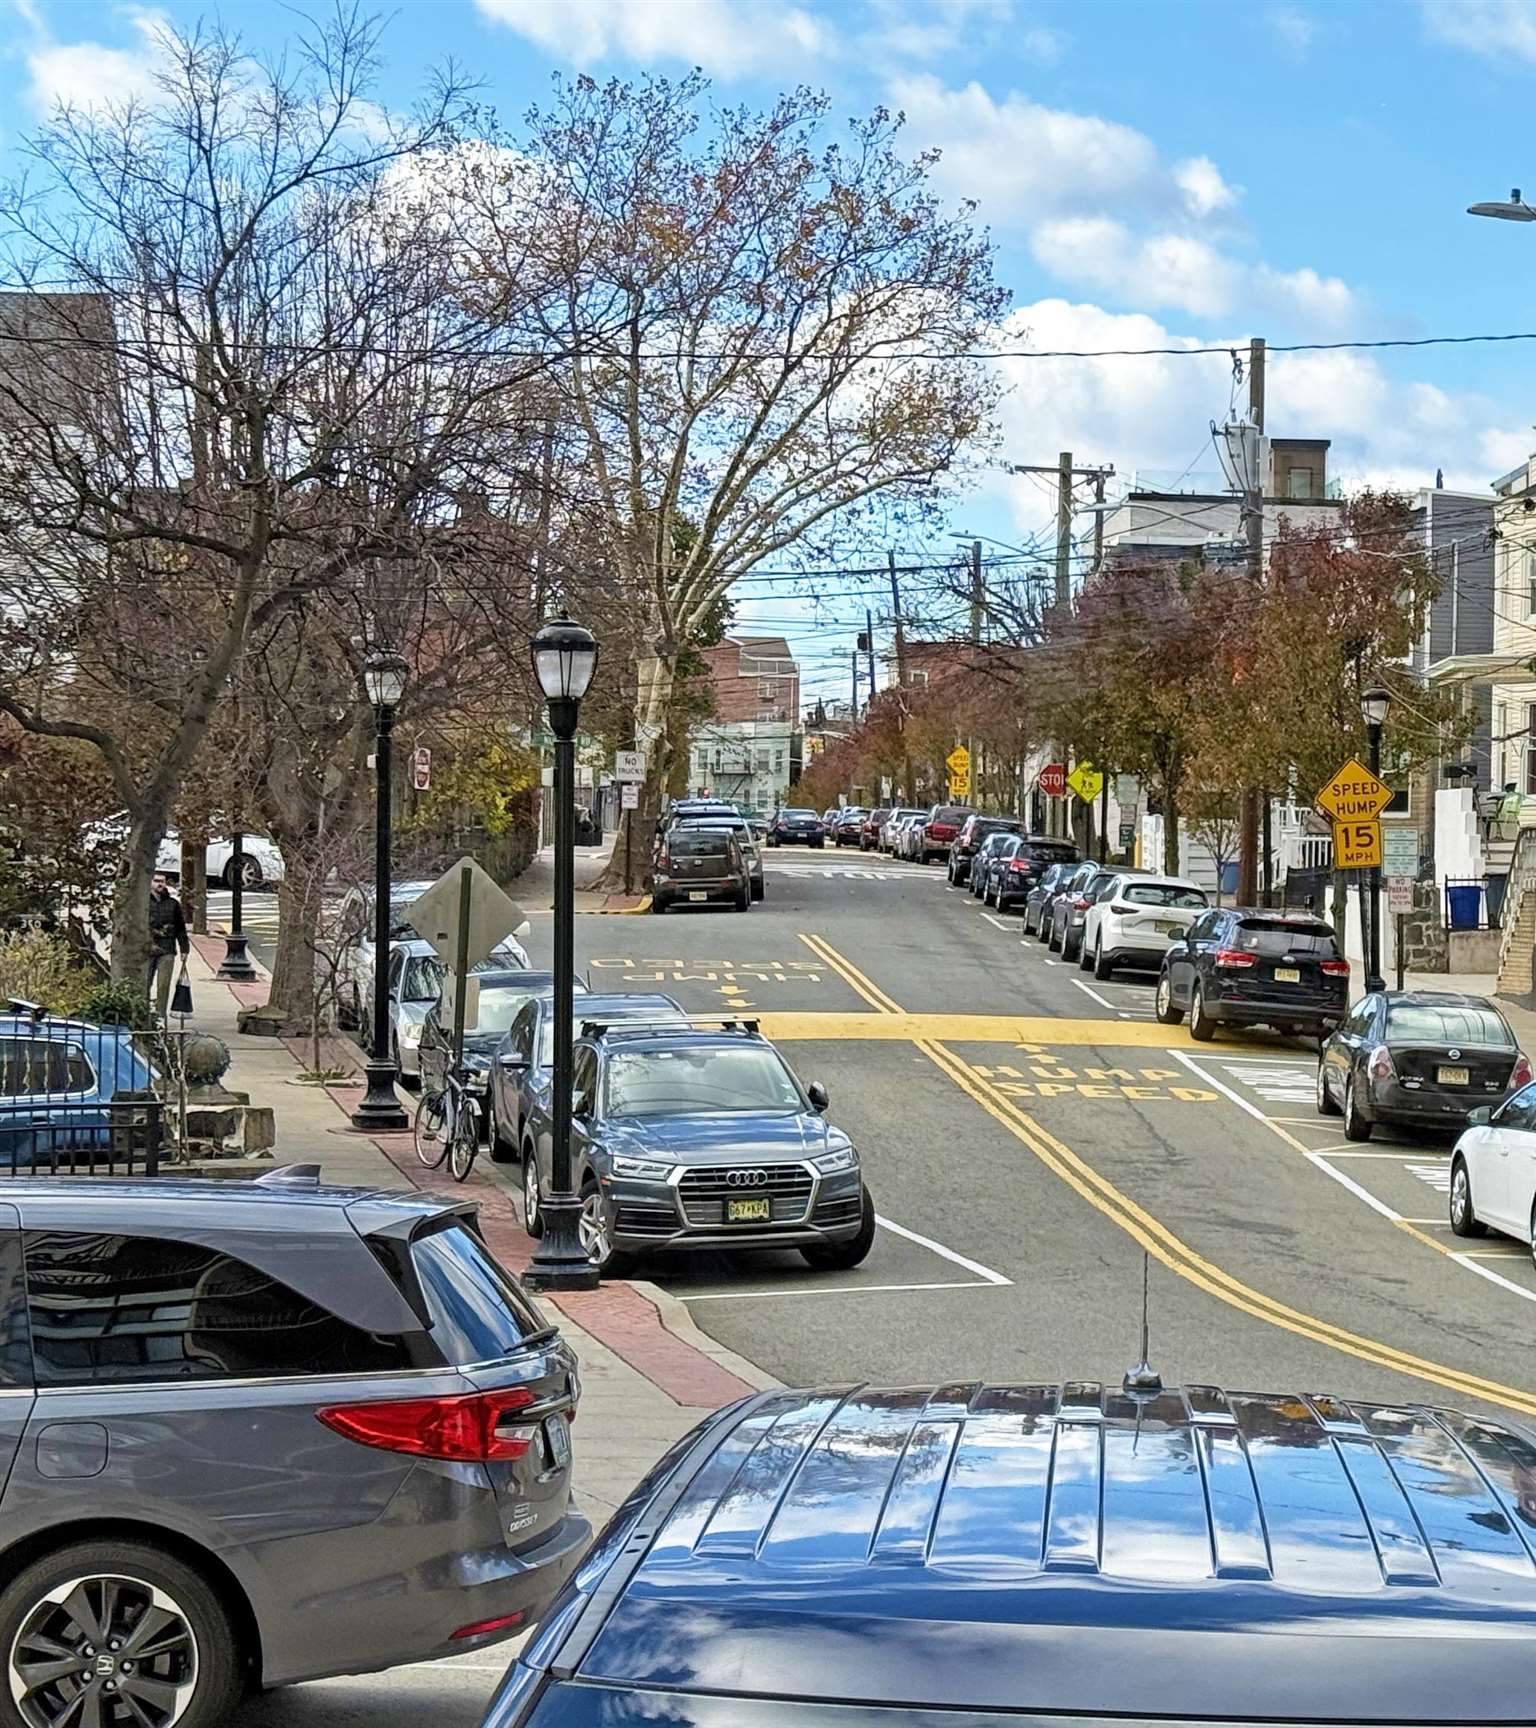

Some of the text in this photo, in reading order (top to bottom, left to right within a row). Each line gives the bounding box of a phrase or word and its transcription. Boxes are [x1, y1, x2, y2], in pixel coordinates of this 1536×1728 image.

[625, 757, 637, 766] NO
[954, 778, 967, 788] 15
[1332, 782, 1380, 797] SPEED
[1336, 801, 1378, 815] HUMP
[1341, 825, 1375, 849] 15
[1345, 852, 1374, 863] MPH
[590, 959, 827, 970] SPEED
[623, 972, 821, 982] HUMP
[971, 1066, 1183, 1081] HUMP
[991, 1082, 1219, 1101] SPEED
